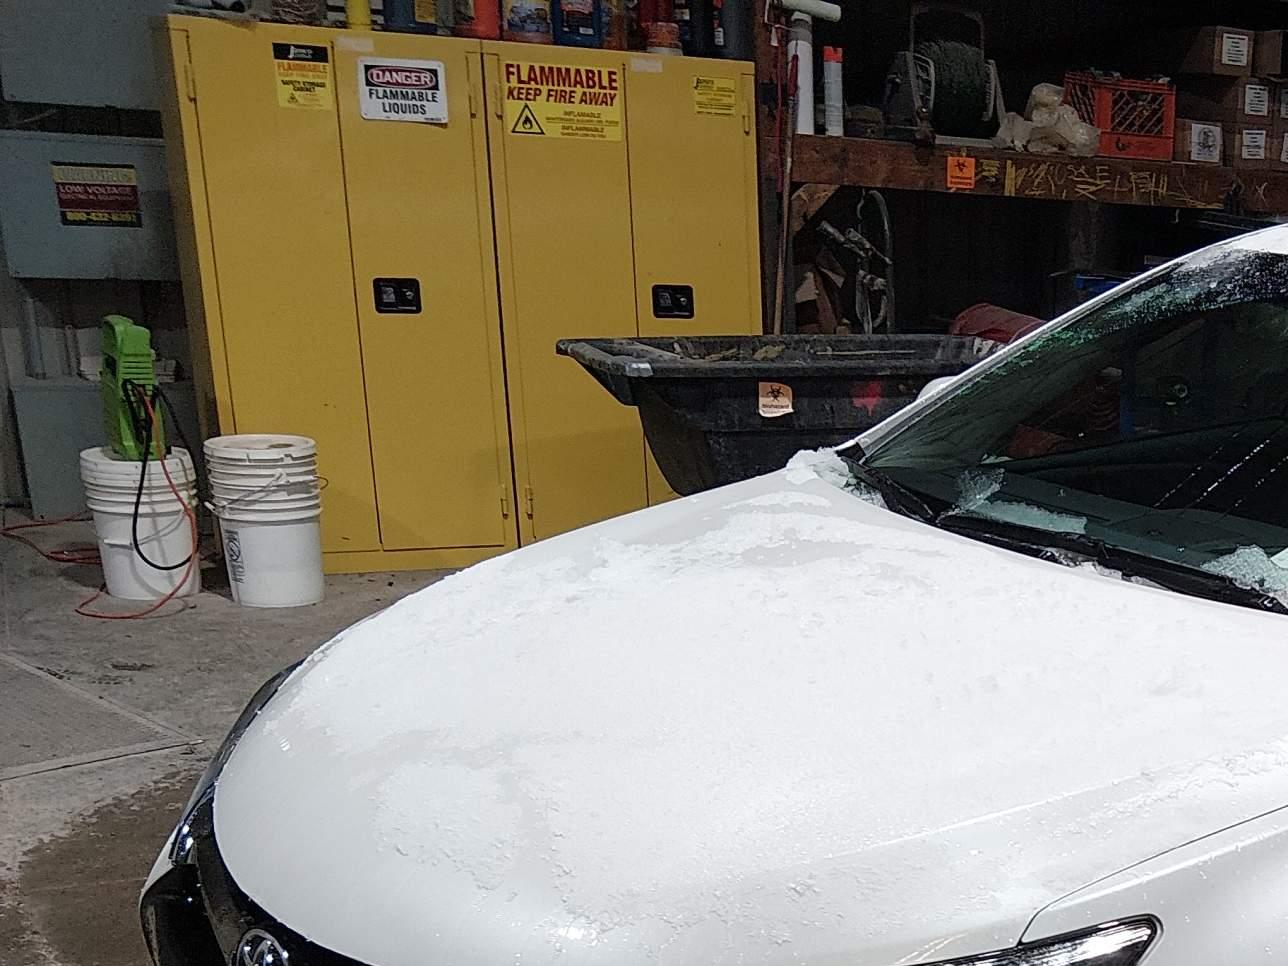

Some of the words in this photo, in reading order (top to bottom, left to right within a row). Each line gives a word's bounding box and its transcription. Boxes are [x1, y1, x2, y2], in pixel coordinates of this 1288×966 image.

[372, 70, 431, 86] DANGER
[505, 63, 618, 91] FLAMMABLE
[368, 88, 439, 103] FLAMMABLE
[507, 86, 542, 101] KEEP
[546, 89, 576, 104] FIRE
[579, 91, 617, 107] AWAY
[381, 102, 427, 115] LIQUIDS
[60, 184, 84, 193] LOW
